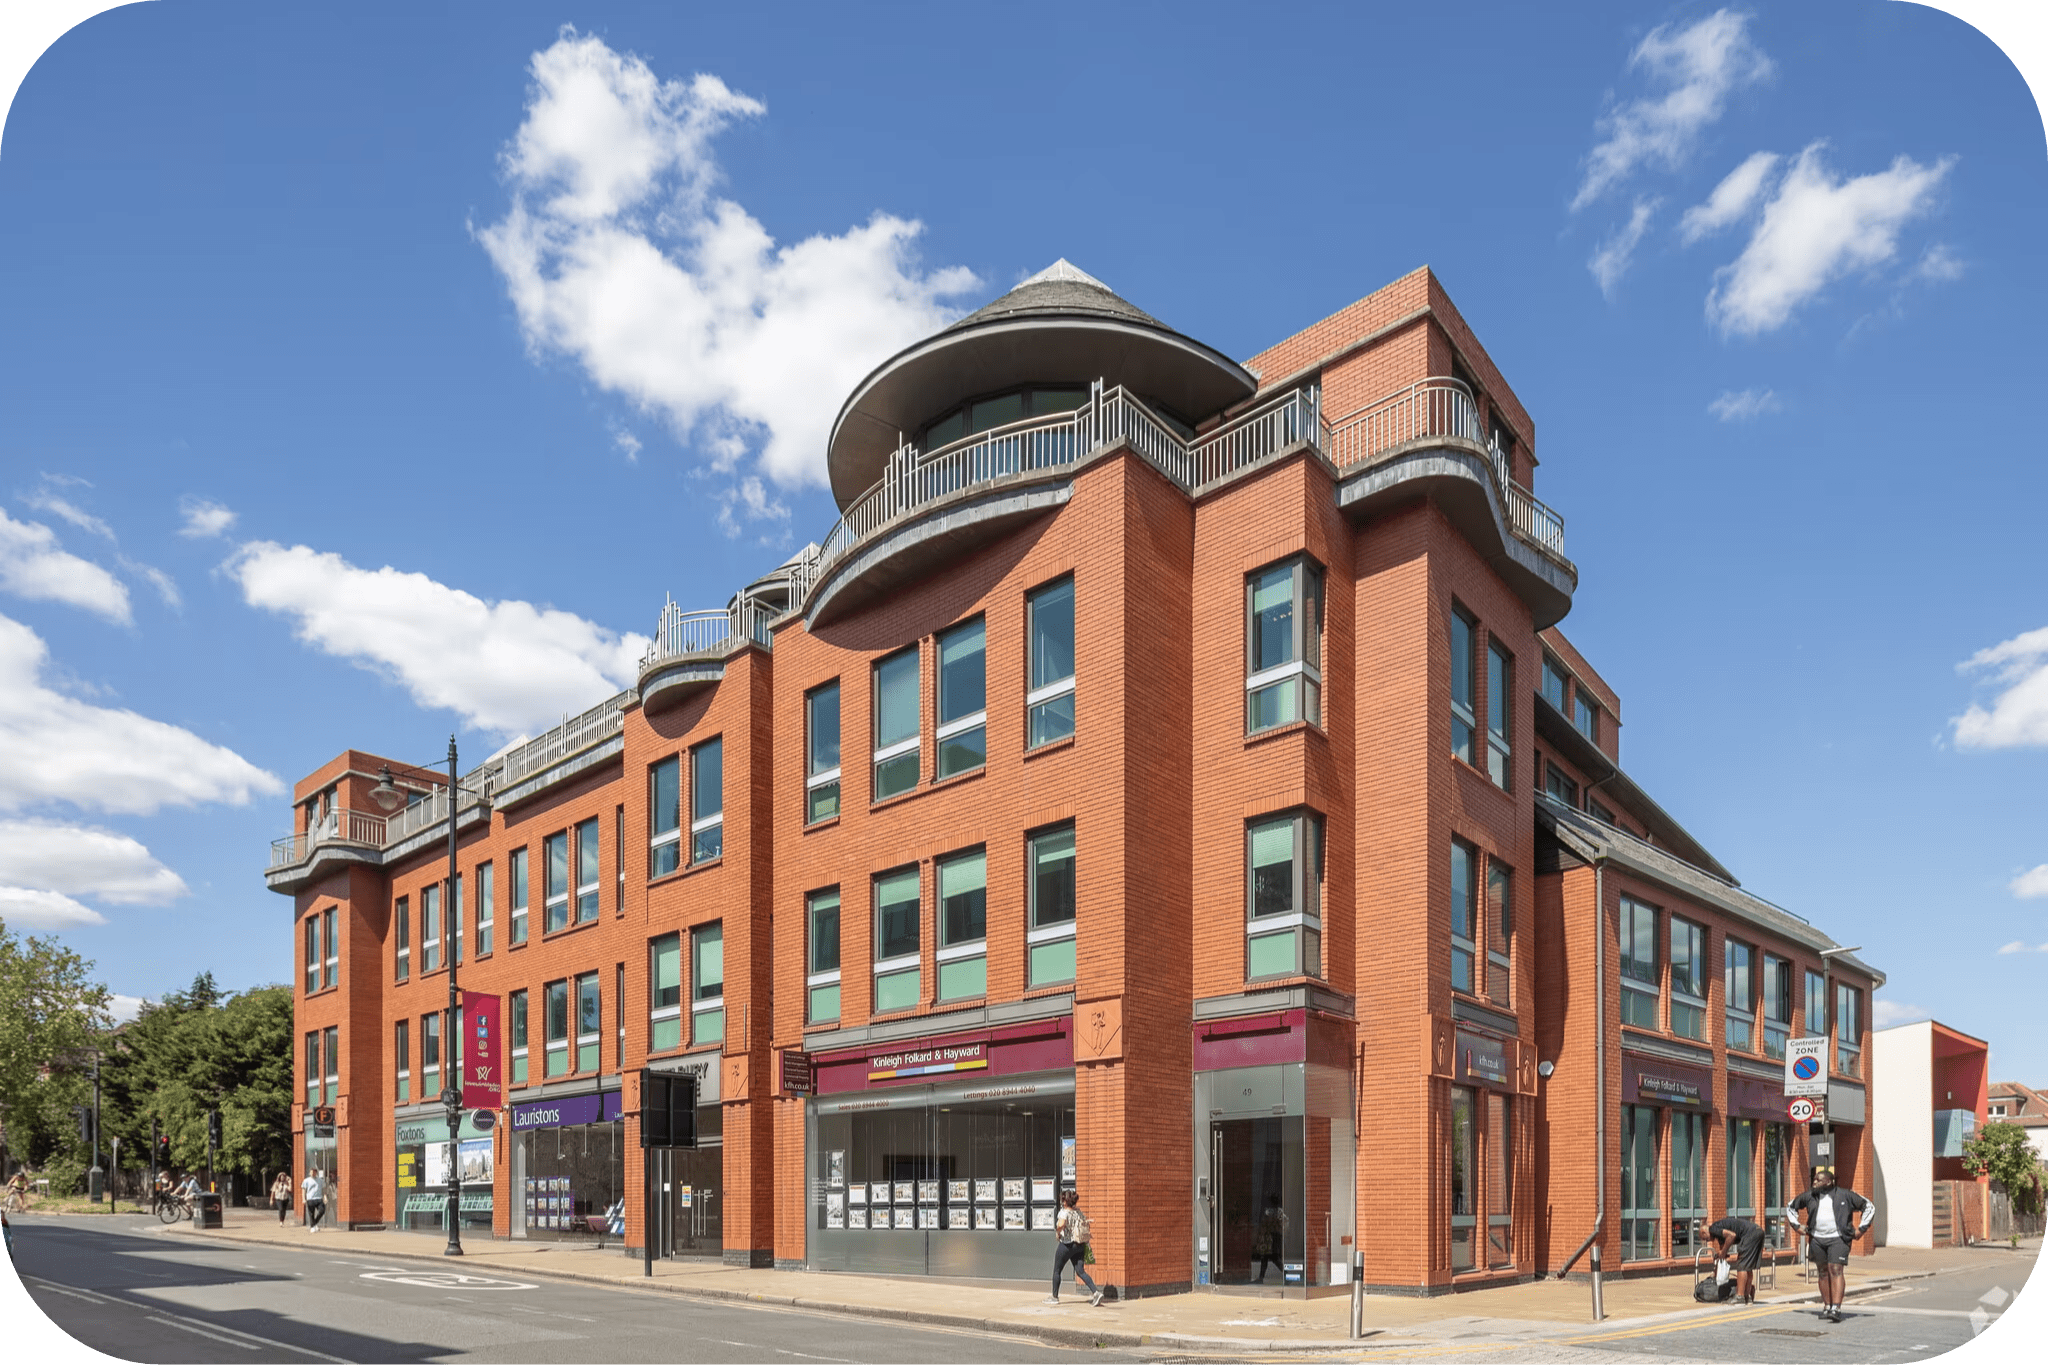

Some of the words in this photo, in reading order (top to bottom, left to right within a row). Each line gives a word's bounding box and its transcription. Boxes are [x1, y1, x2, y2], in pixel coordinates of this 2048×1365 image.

[1790, 1039, 1825, 1047] Controlled
[873, 1055, 903, 1068] Kinleigh
[904, 1051, 932, 1064] Folkard
[934, 1049, 942, 1060] &
[943, 1045, 980, 1061] Hayward
[785, 1081, 810, 1090] kfh.co.uk
[963, 1091, 988, 1100] Lettings
[988, 1089, 1001, 1098] 020
[1002, 1087, 1018, 1096] 8944
[1243, 1088, 1252, 1096] 49
[838, 1103, 851, 1111] Sales
[1792, 1105, 1811, 1115] 20
[514, 1107, 560, 1127] Lauristons
[397, 1126, 425, 1141] Foxtons
